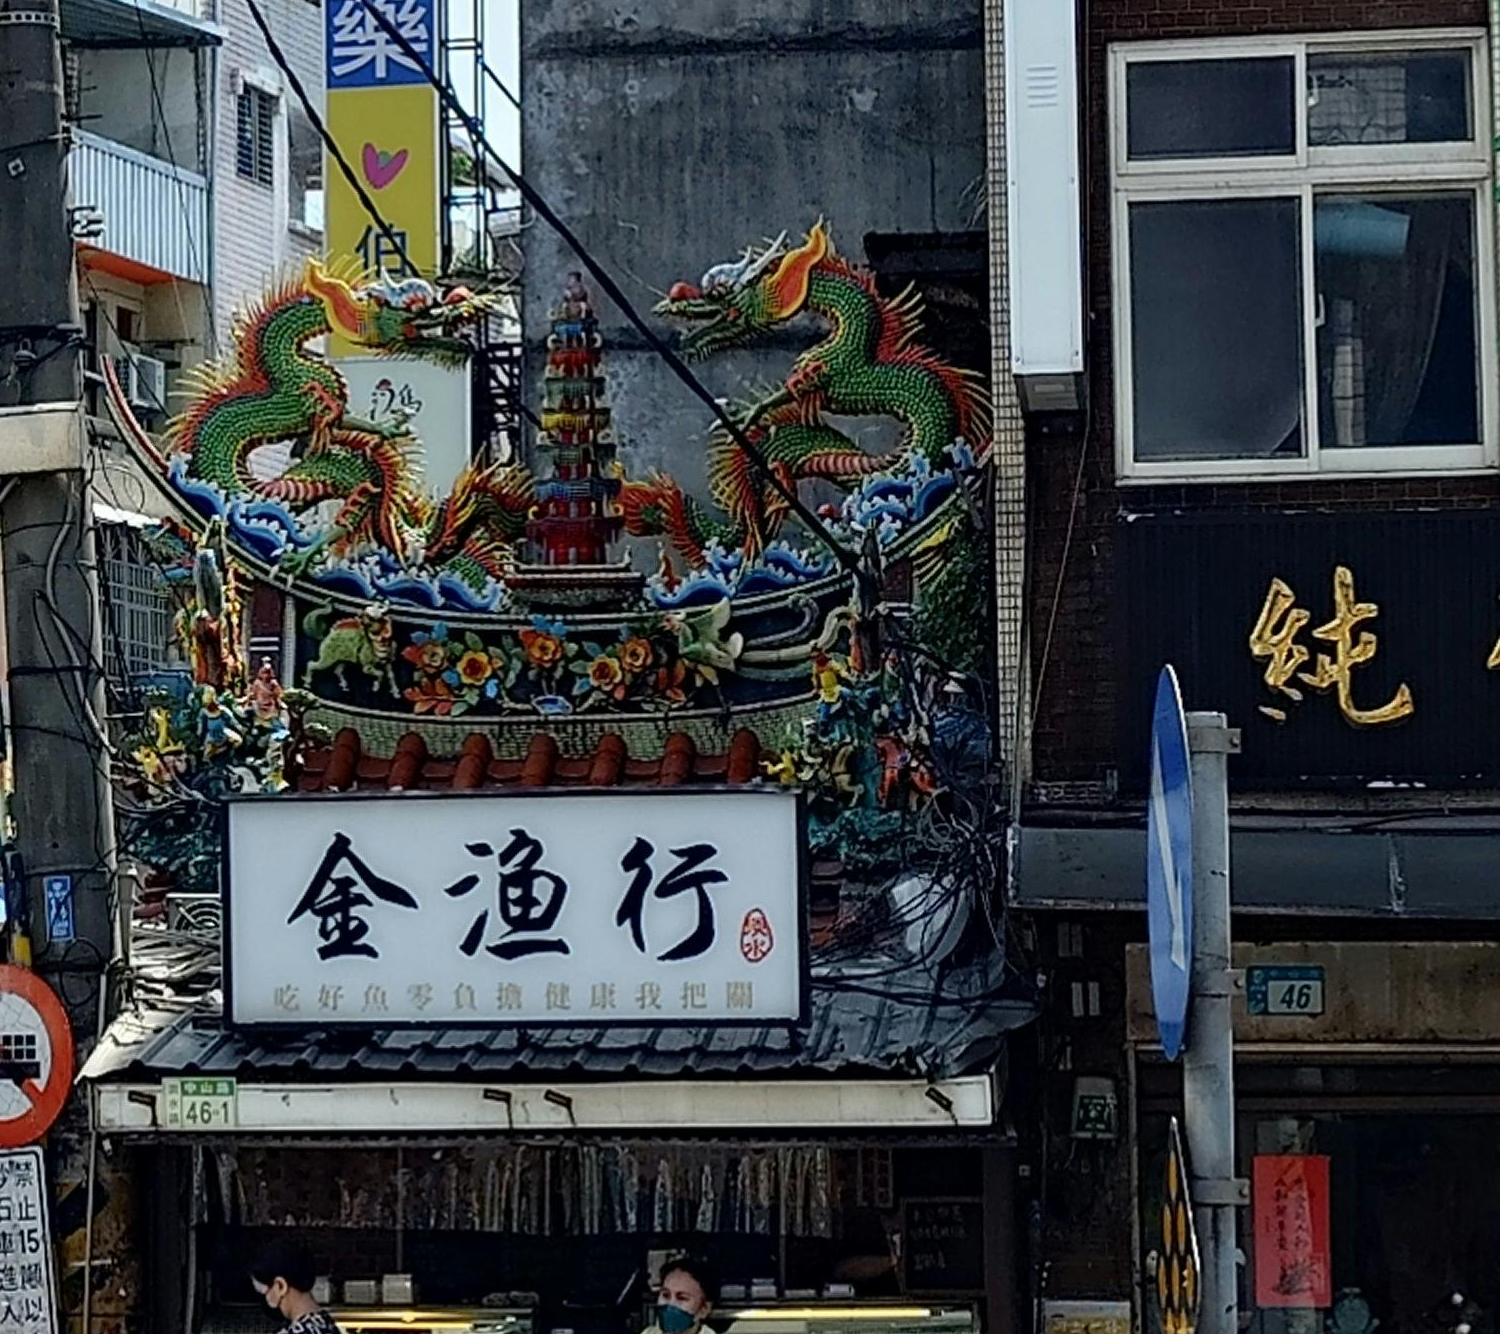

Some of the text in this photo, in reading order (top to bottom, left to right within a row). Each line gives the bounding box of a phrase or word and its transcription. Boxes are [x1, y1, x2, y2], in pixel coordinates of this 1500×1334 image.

[274, 981, 754, 1012] 吃好魚零負擔健康我把關
[1280, 983, 1312, 1009] 46
